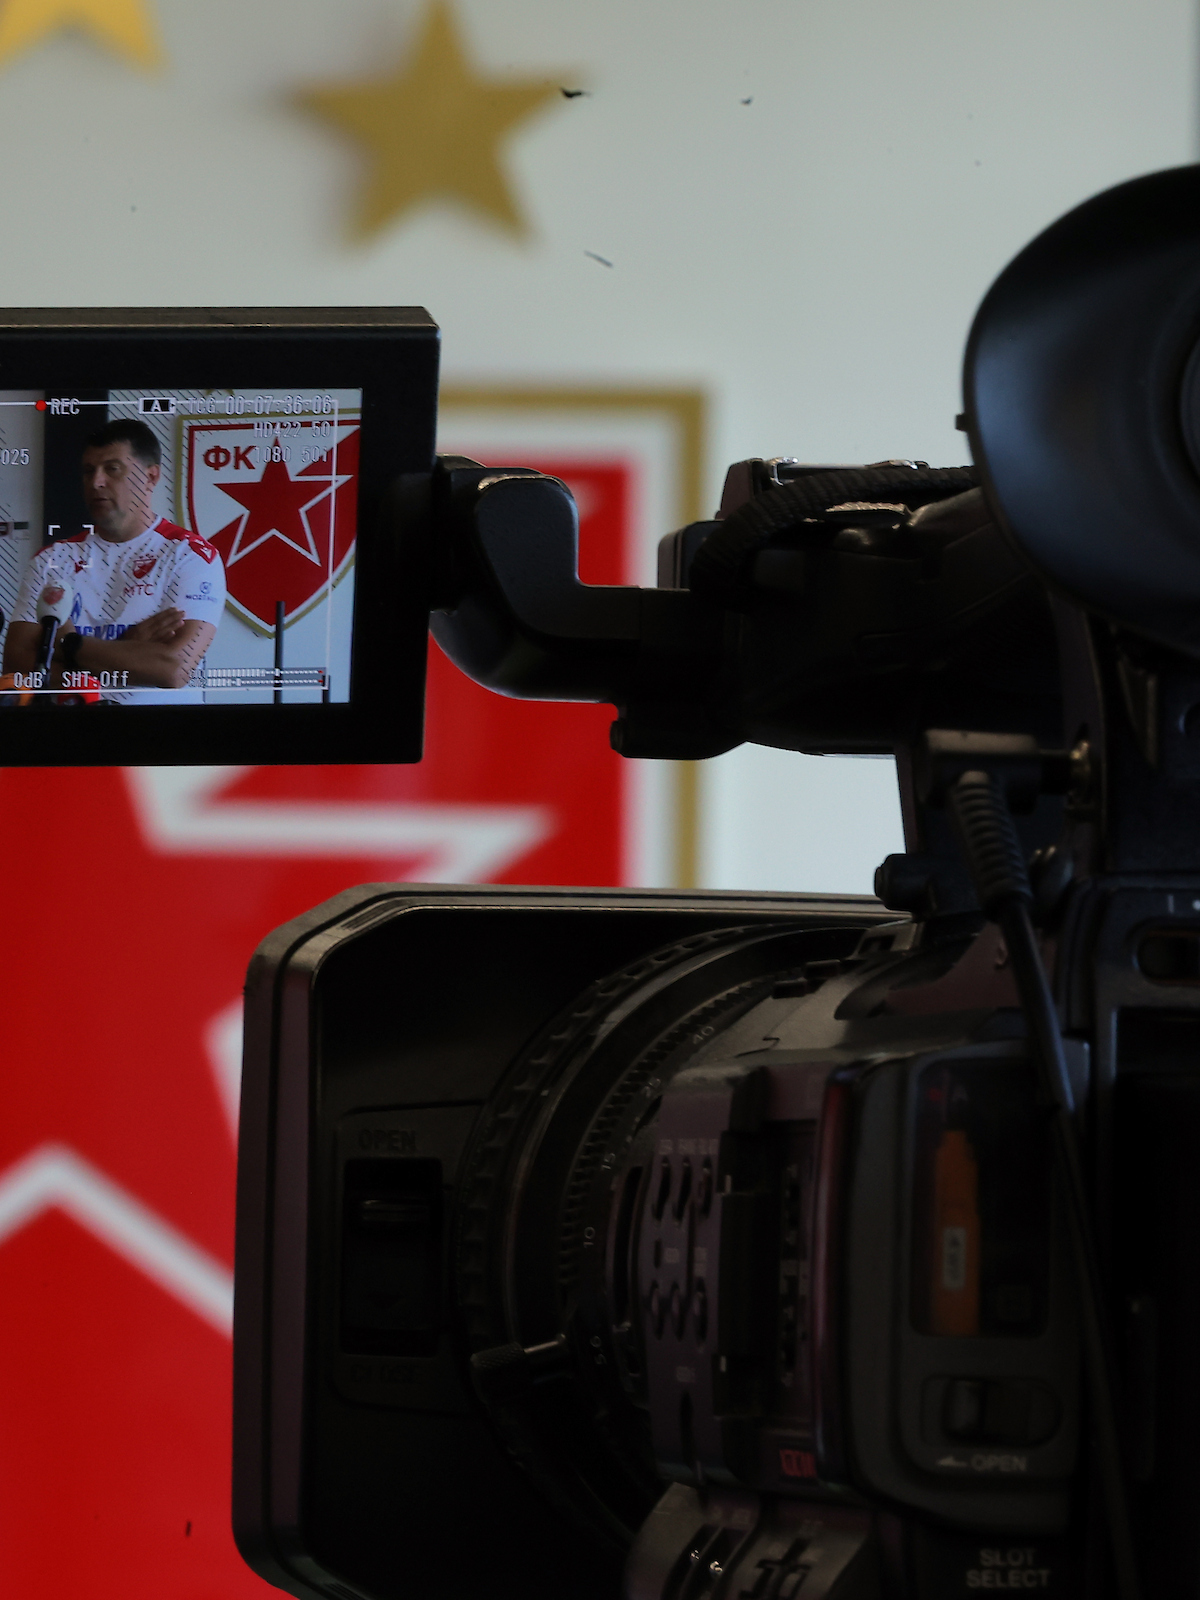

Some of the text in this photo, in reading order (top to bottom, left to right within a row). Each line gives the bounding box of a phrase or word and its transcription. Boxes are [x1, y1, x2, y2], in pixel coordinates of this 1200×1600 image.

[50, 398, 80, 416] REC
[253, 421, 332, 438] HD422 50
[203, 445, 257, 471] ФК
[255, 446, 291, 463] 1080
[13, 671, 44, 688] 0dB
[61, 669, 130, 688] SHT:Off
[970, 1453, 1028, 1472] OPEN
[978, 1547, 1036, 1567] SLOT
[966, 1567, 1051, 1588] SELECT
